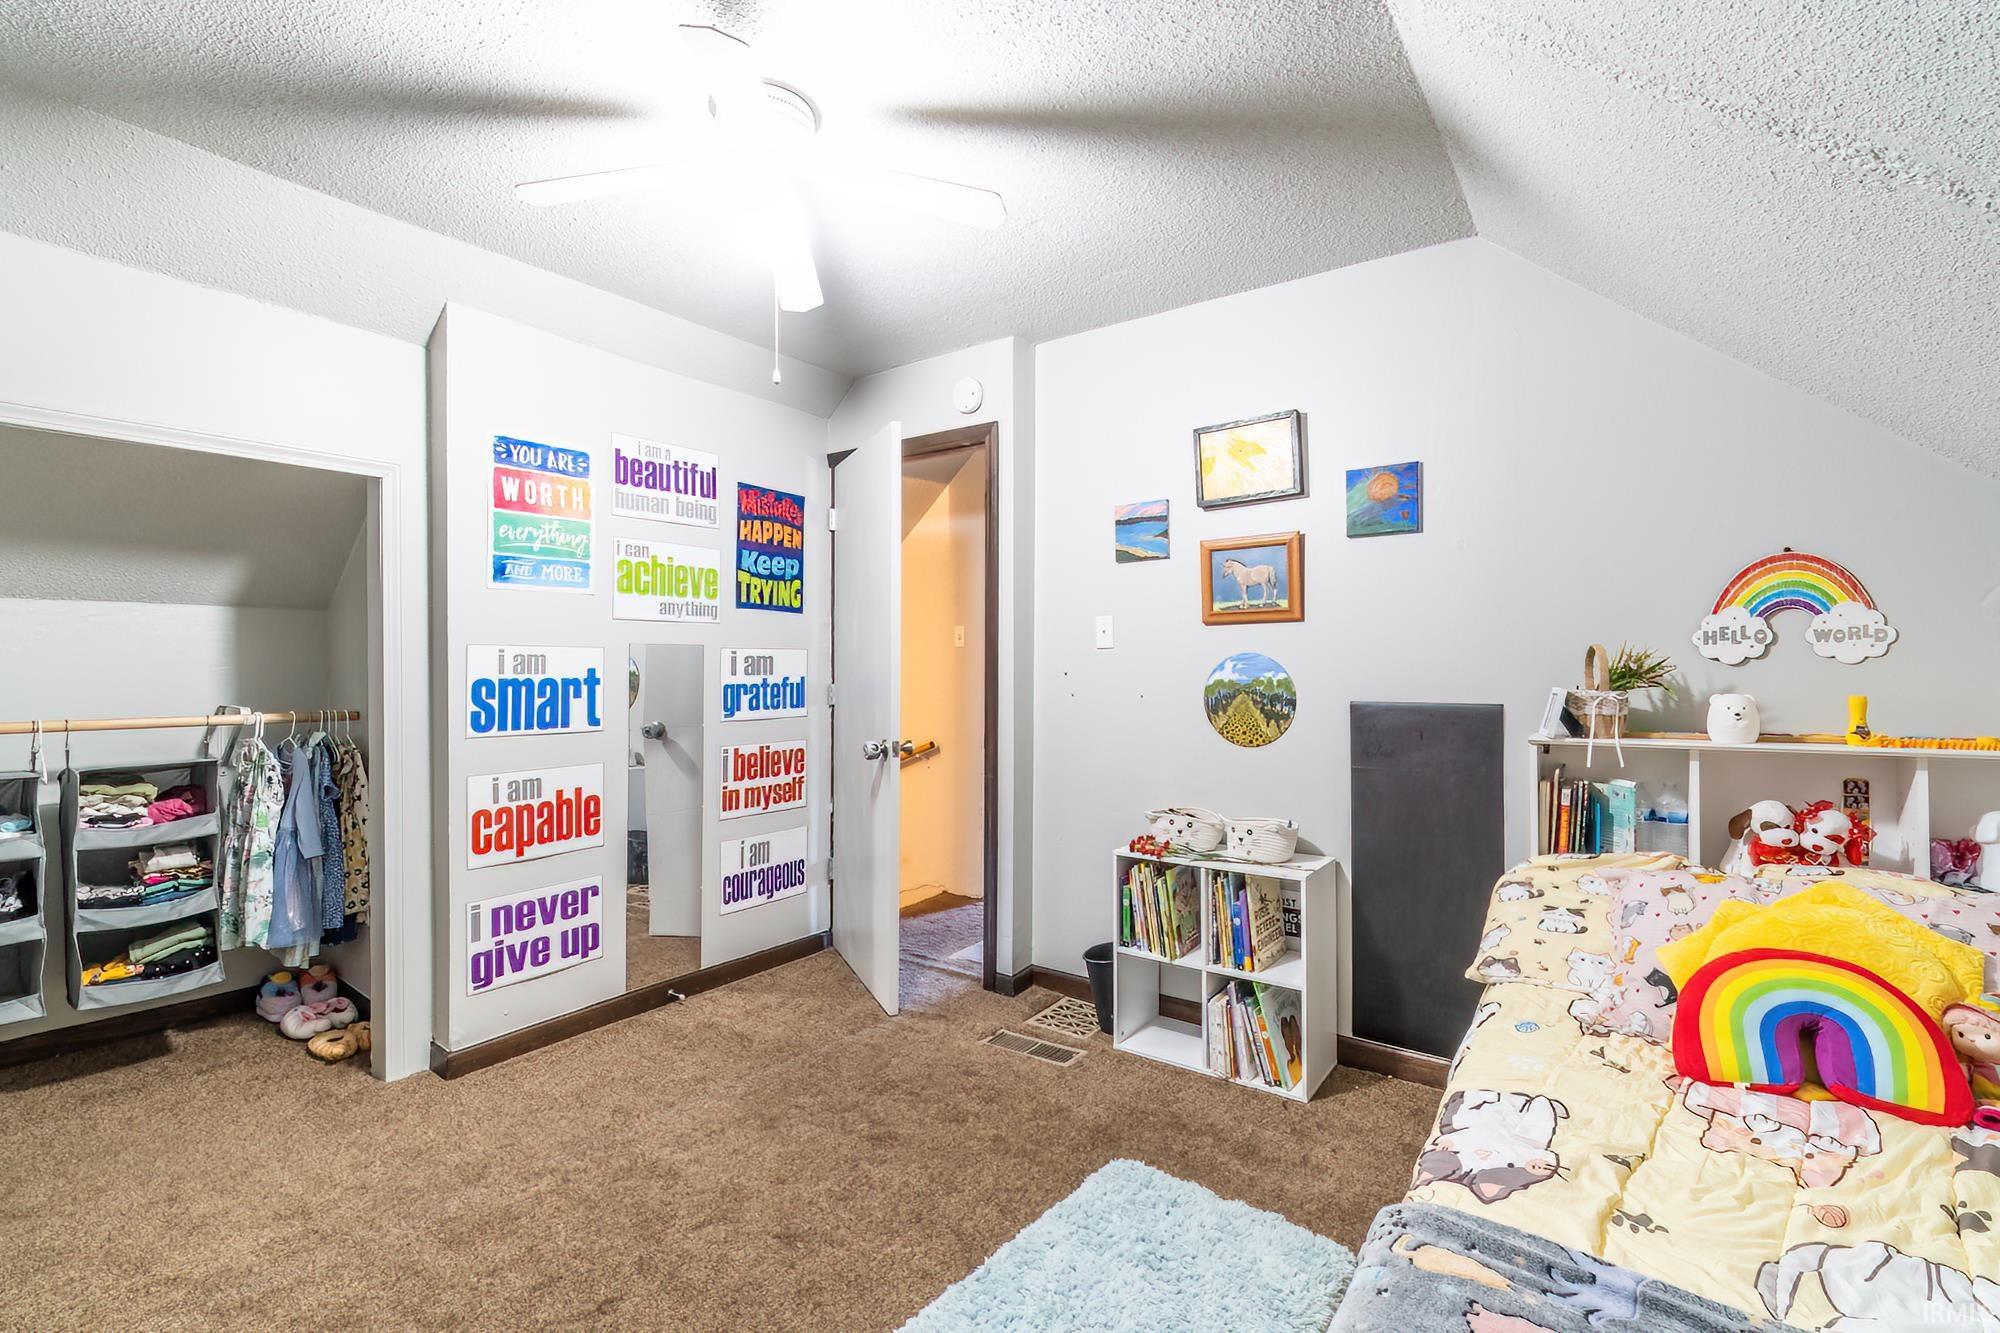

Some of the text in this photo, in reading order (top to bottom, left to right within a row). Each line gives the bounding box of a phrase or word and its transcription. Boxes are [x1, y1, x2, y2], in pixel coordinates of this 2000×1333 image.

[509, 443, 577, 473] YOU ARE
[637, 440, 672, 462] i am a
[614, 447, 717, 500] beautiful
[501, 475, 585, 513] WORTH
[614, 487, 717, 525] human being
[498, 519, 589, 559] everything
[616, 540, 650, 559] i can
[739, 519, 803, 550] HAPPEN
[505, 562, 584, 583] AND MORE
[616, 554, 719, 601] achieve
[741, 548, 801, 581] Keep
[737, 568, 803, 610] TRYING
[658, 601, 719, 621] anything
[1702, 623, 1889, 646] HELLO WORLD
[498, 648, 547, 675] i am
[730, 650, 774, 676] i am
[470, 667, 601, 734] smart
[723, 676, 805, 719] grateful
[722, 744, 805, 783] i believe
[492, 776, 542, 805] i am
[721, 775, 805, 812] in myself
[471, 786, 601, 858] capable
[740, 840, 770, 869] i am
[722, 858, 805, 906] courageous
[470, 885, 600, 944] i never
[471, 922, 600, 991] give up
